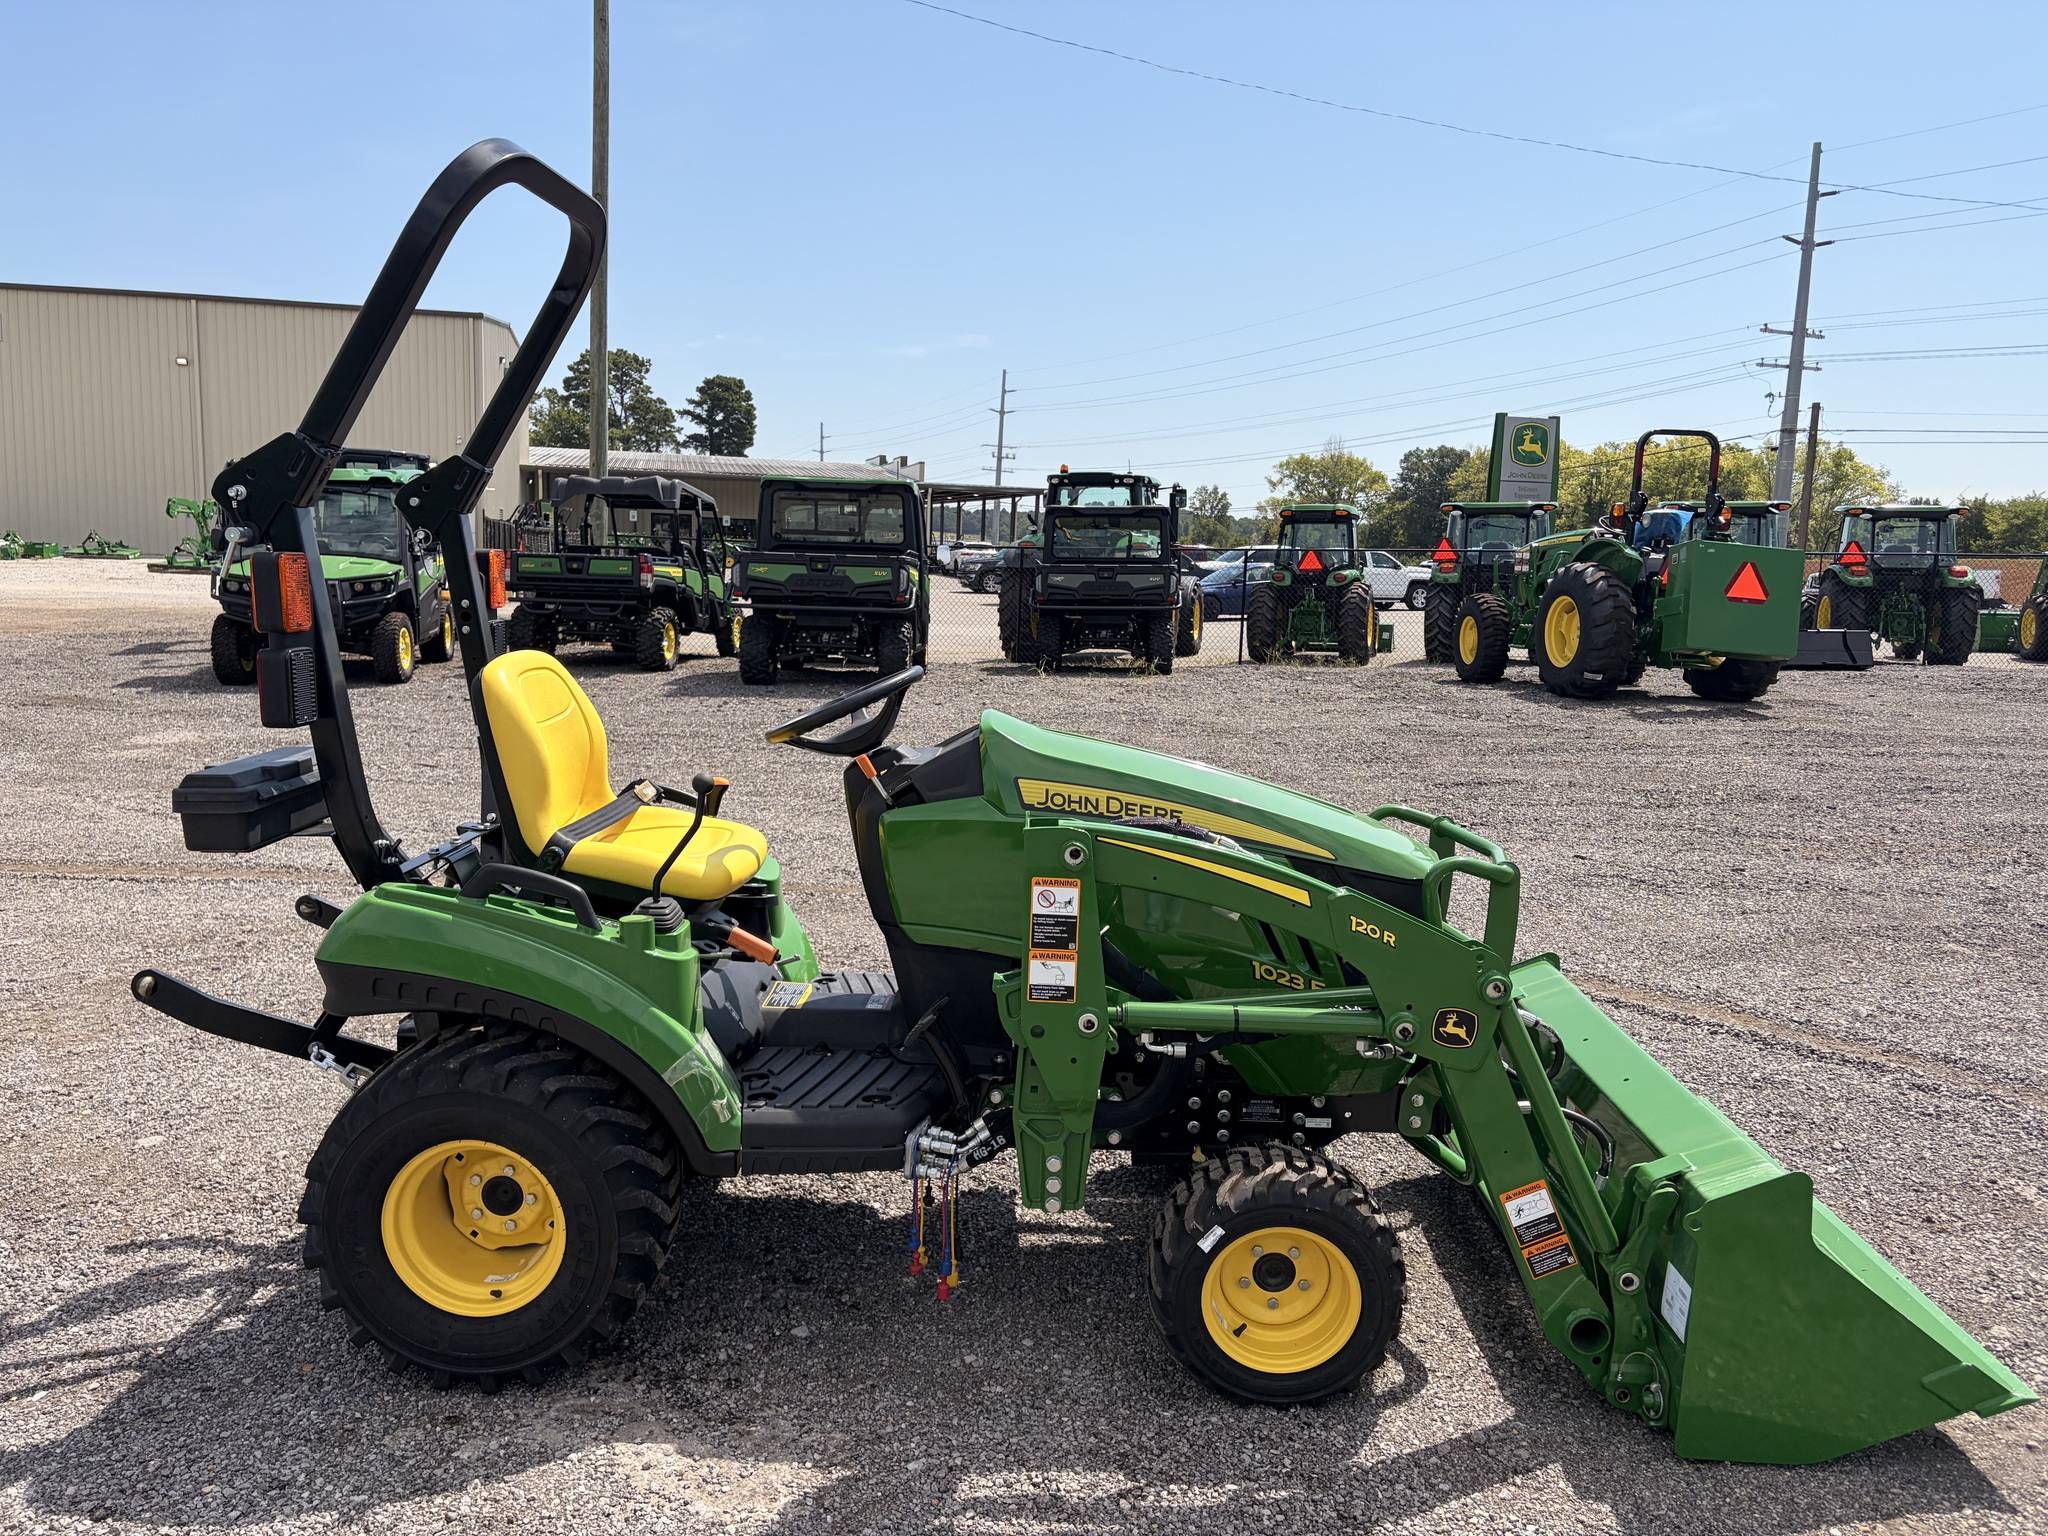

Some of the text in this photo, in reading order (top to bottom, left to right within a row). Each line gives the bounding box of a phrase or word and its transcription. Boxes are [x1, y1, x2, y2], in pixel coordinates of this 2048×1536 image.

[1507, 471, 1548, 480] JOHN DEERE
[1036, 788, 1184, 821] JOHN DEERE
[1041, 879, 1078, 887] WARNING
[1350, 915, 1396, 948] 120 R
[1038, 952, 1075, 961] WARNING
[1251, 960, 1305, 990] 1023
[972, 1134, 1007, 1161] HG-16
[1512, 1183, 1541, 1198] WARNING
[1535, 1238, 1564, 1253] WARNING
